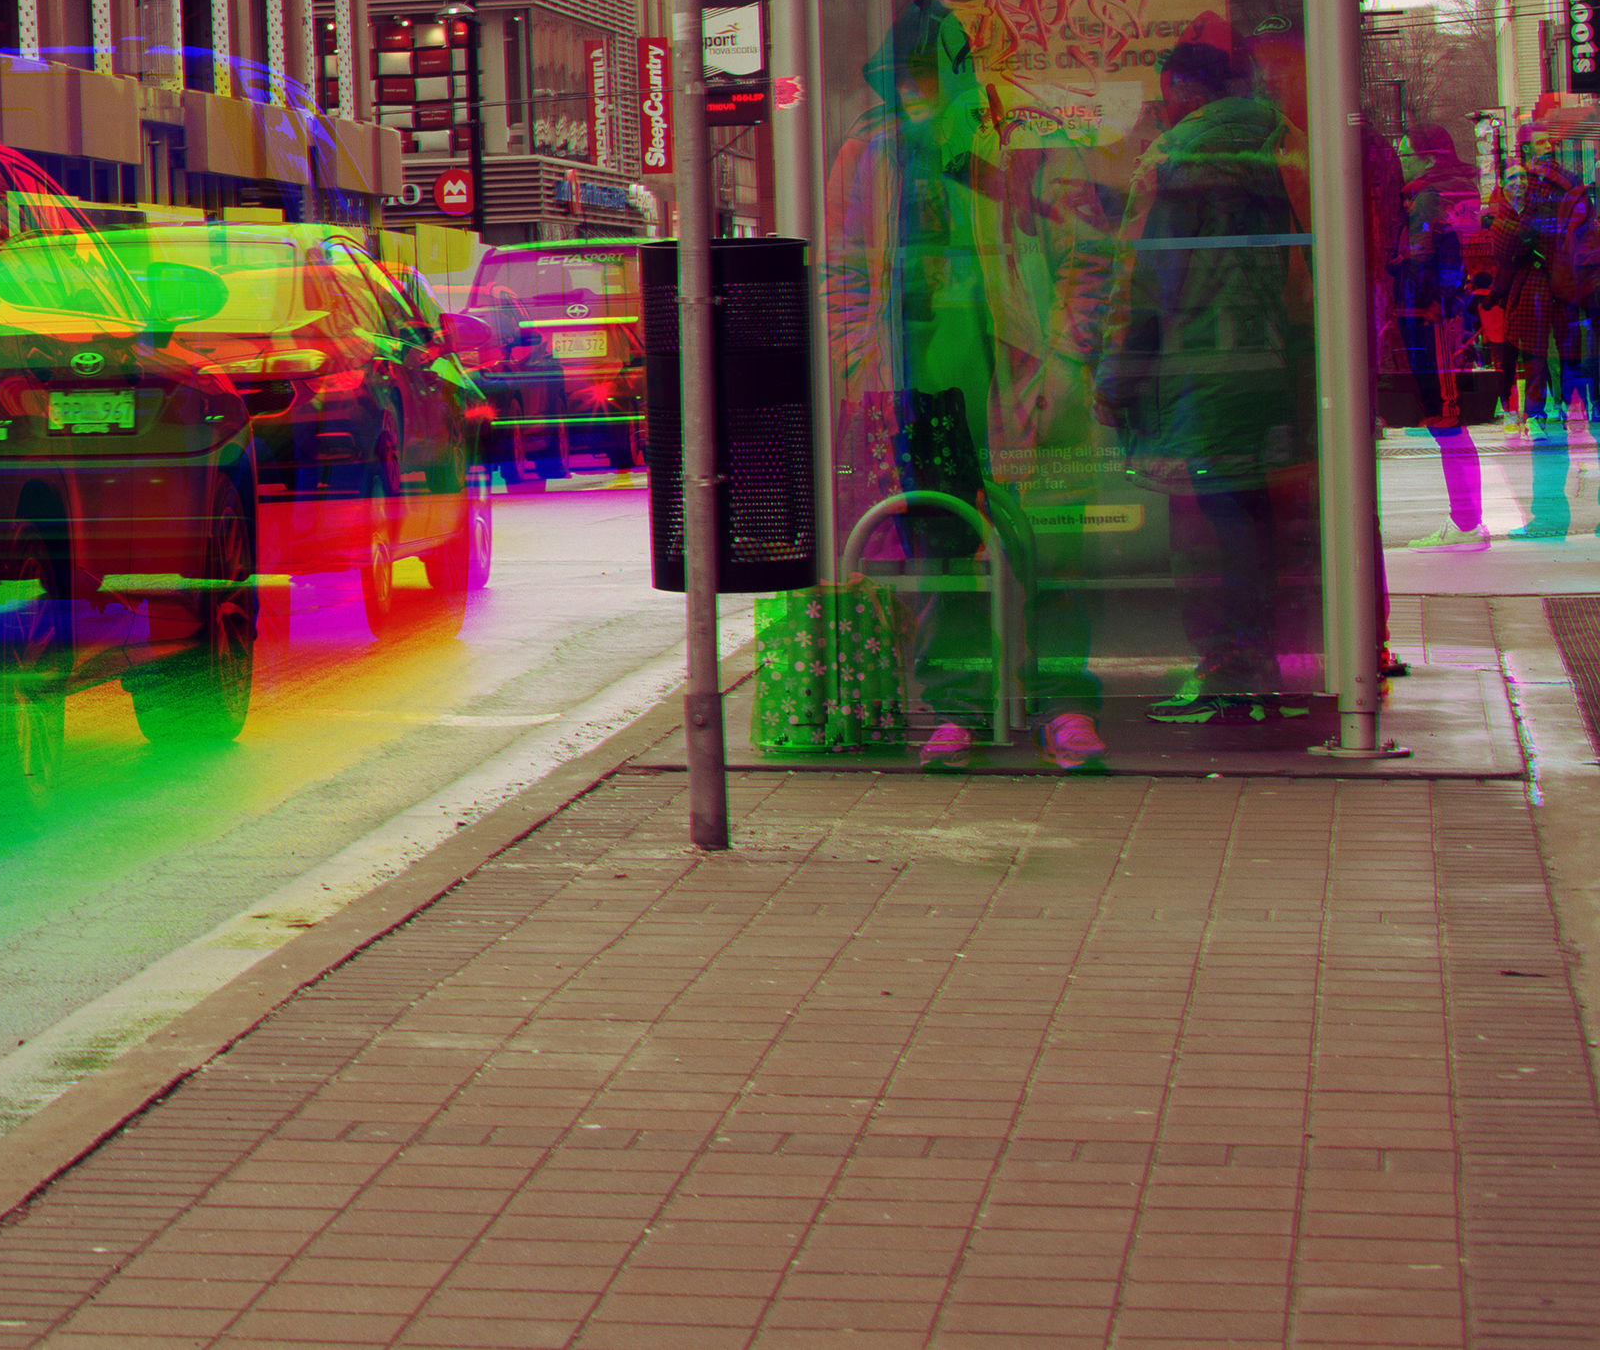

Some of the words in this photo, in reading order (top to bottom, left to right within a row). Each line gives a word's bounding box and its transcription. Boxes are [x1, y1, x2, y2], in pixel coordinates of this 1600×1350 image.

[703, 32, 738, 50] port
[643, 45, 665, 167] SleepCountry
[1075, 445, 1092, 458] all
[1052, 460, 1122, 474] Dalhousie
